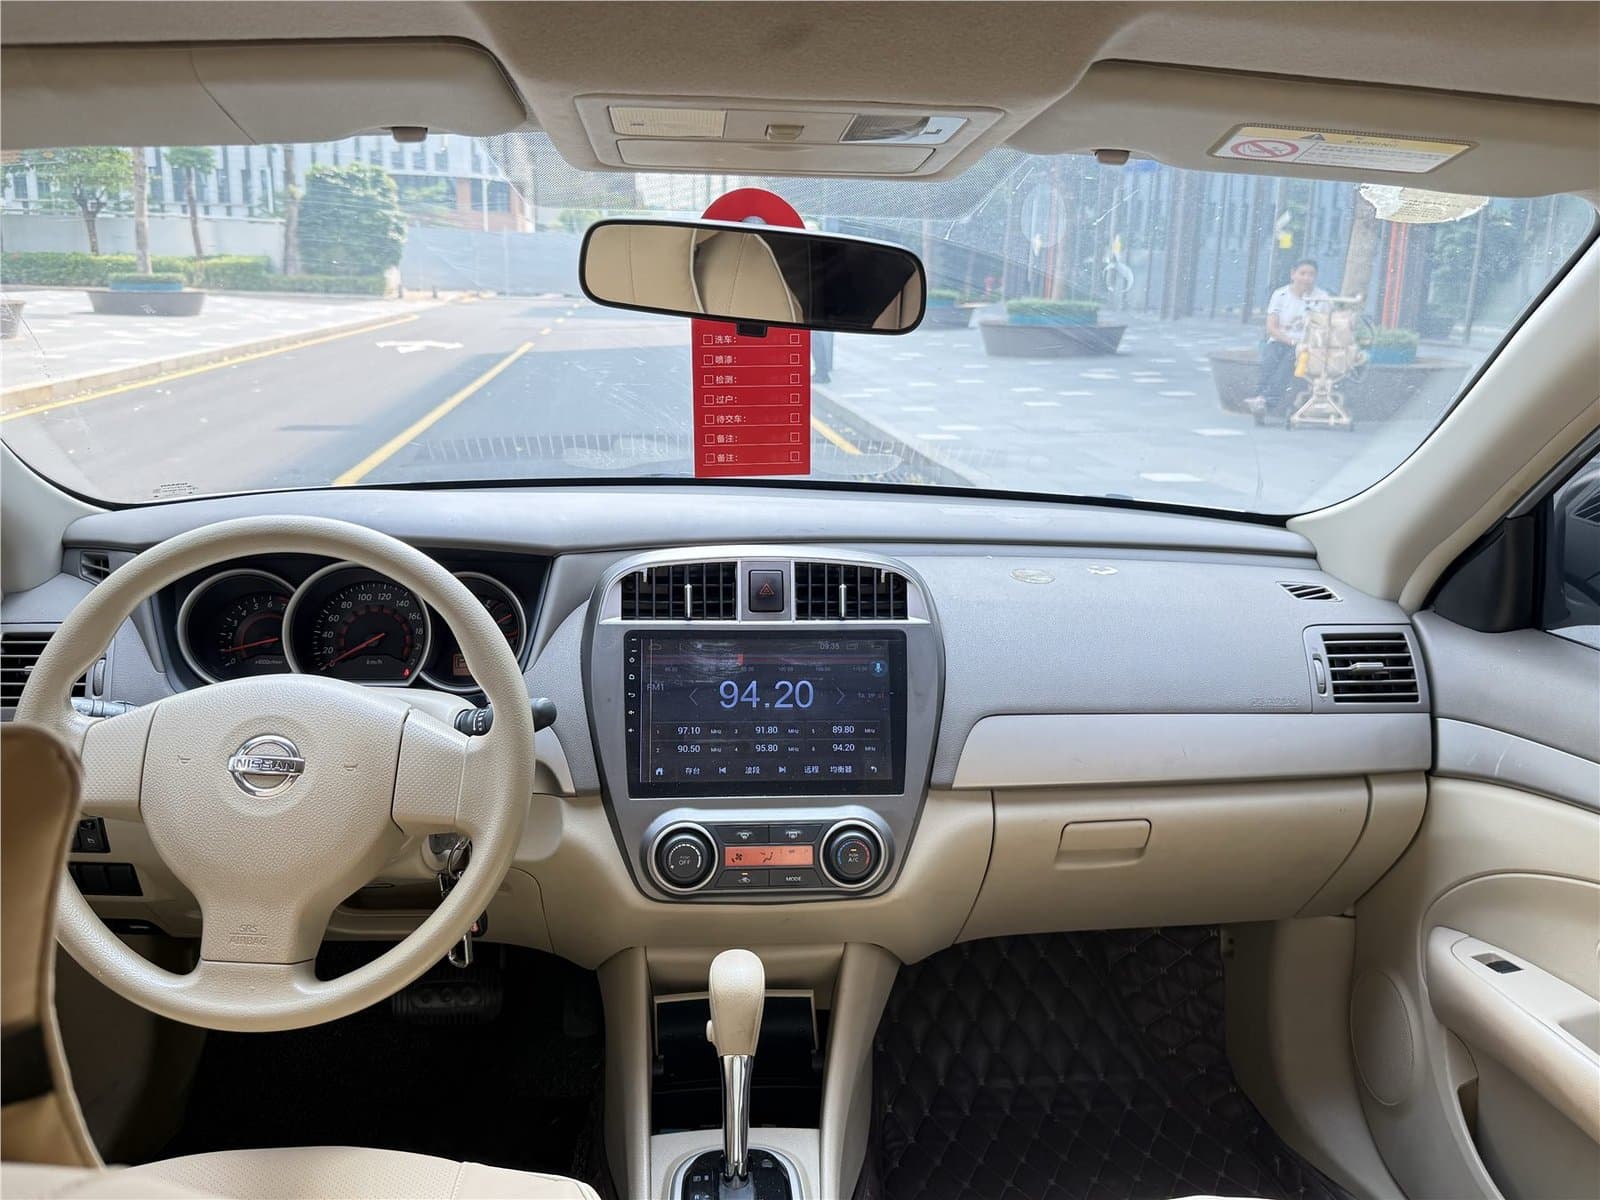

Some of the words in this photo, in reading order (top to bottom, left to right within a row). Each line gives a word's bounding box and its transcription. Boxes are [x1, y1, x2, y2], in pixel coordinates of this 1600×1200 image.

[715, 394, 738, 405] 过户：
[716, 414, 747, 424] 待交车：
[716, 434, 738, 444] 备注：
[716, 453, 739, 463] 备注：
[358, 593, 373, 601] 100
[377, 593, 392, 601] 120
[341, 601, 353, 609] 80
[328, 614, 340, 622] 60
[719, 680, 815, 709] 94.20
[677, 726, 701, 735] 97.10
[755, 726, 778, 734] 91.80
[832, 725, 855, 734] 89.80
[677, 744, 701, 753] 90.50
[755, 744, 778, 752] 95.80
[832, 743, 855, 752] 94.20
[234, 758, 297, 773] NISSAN
